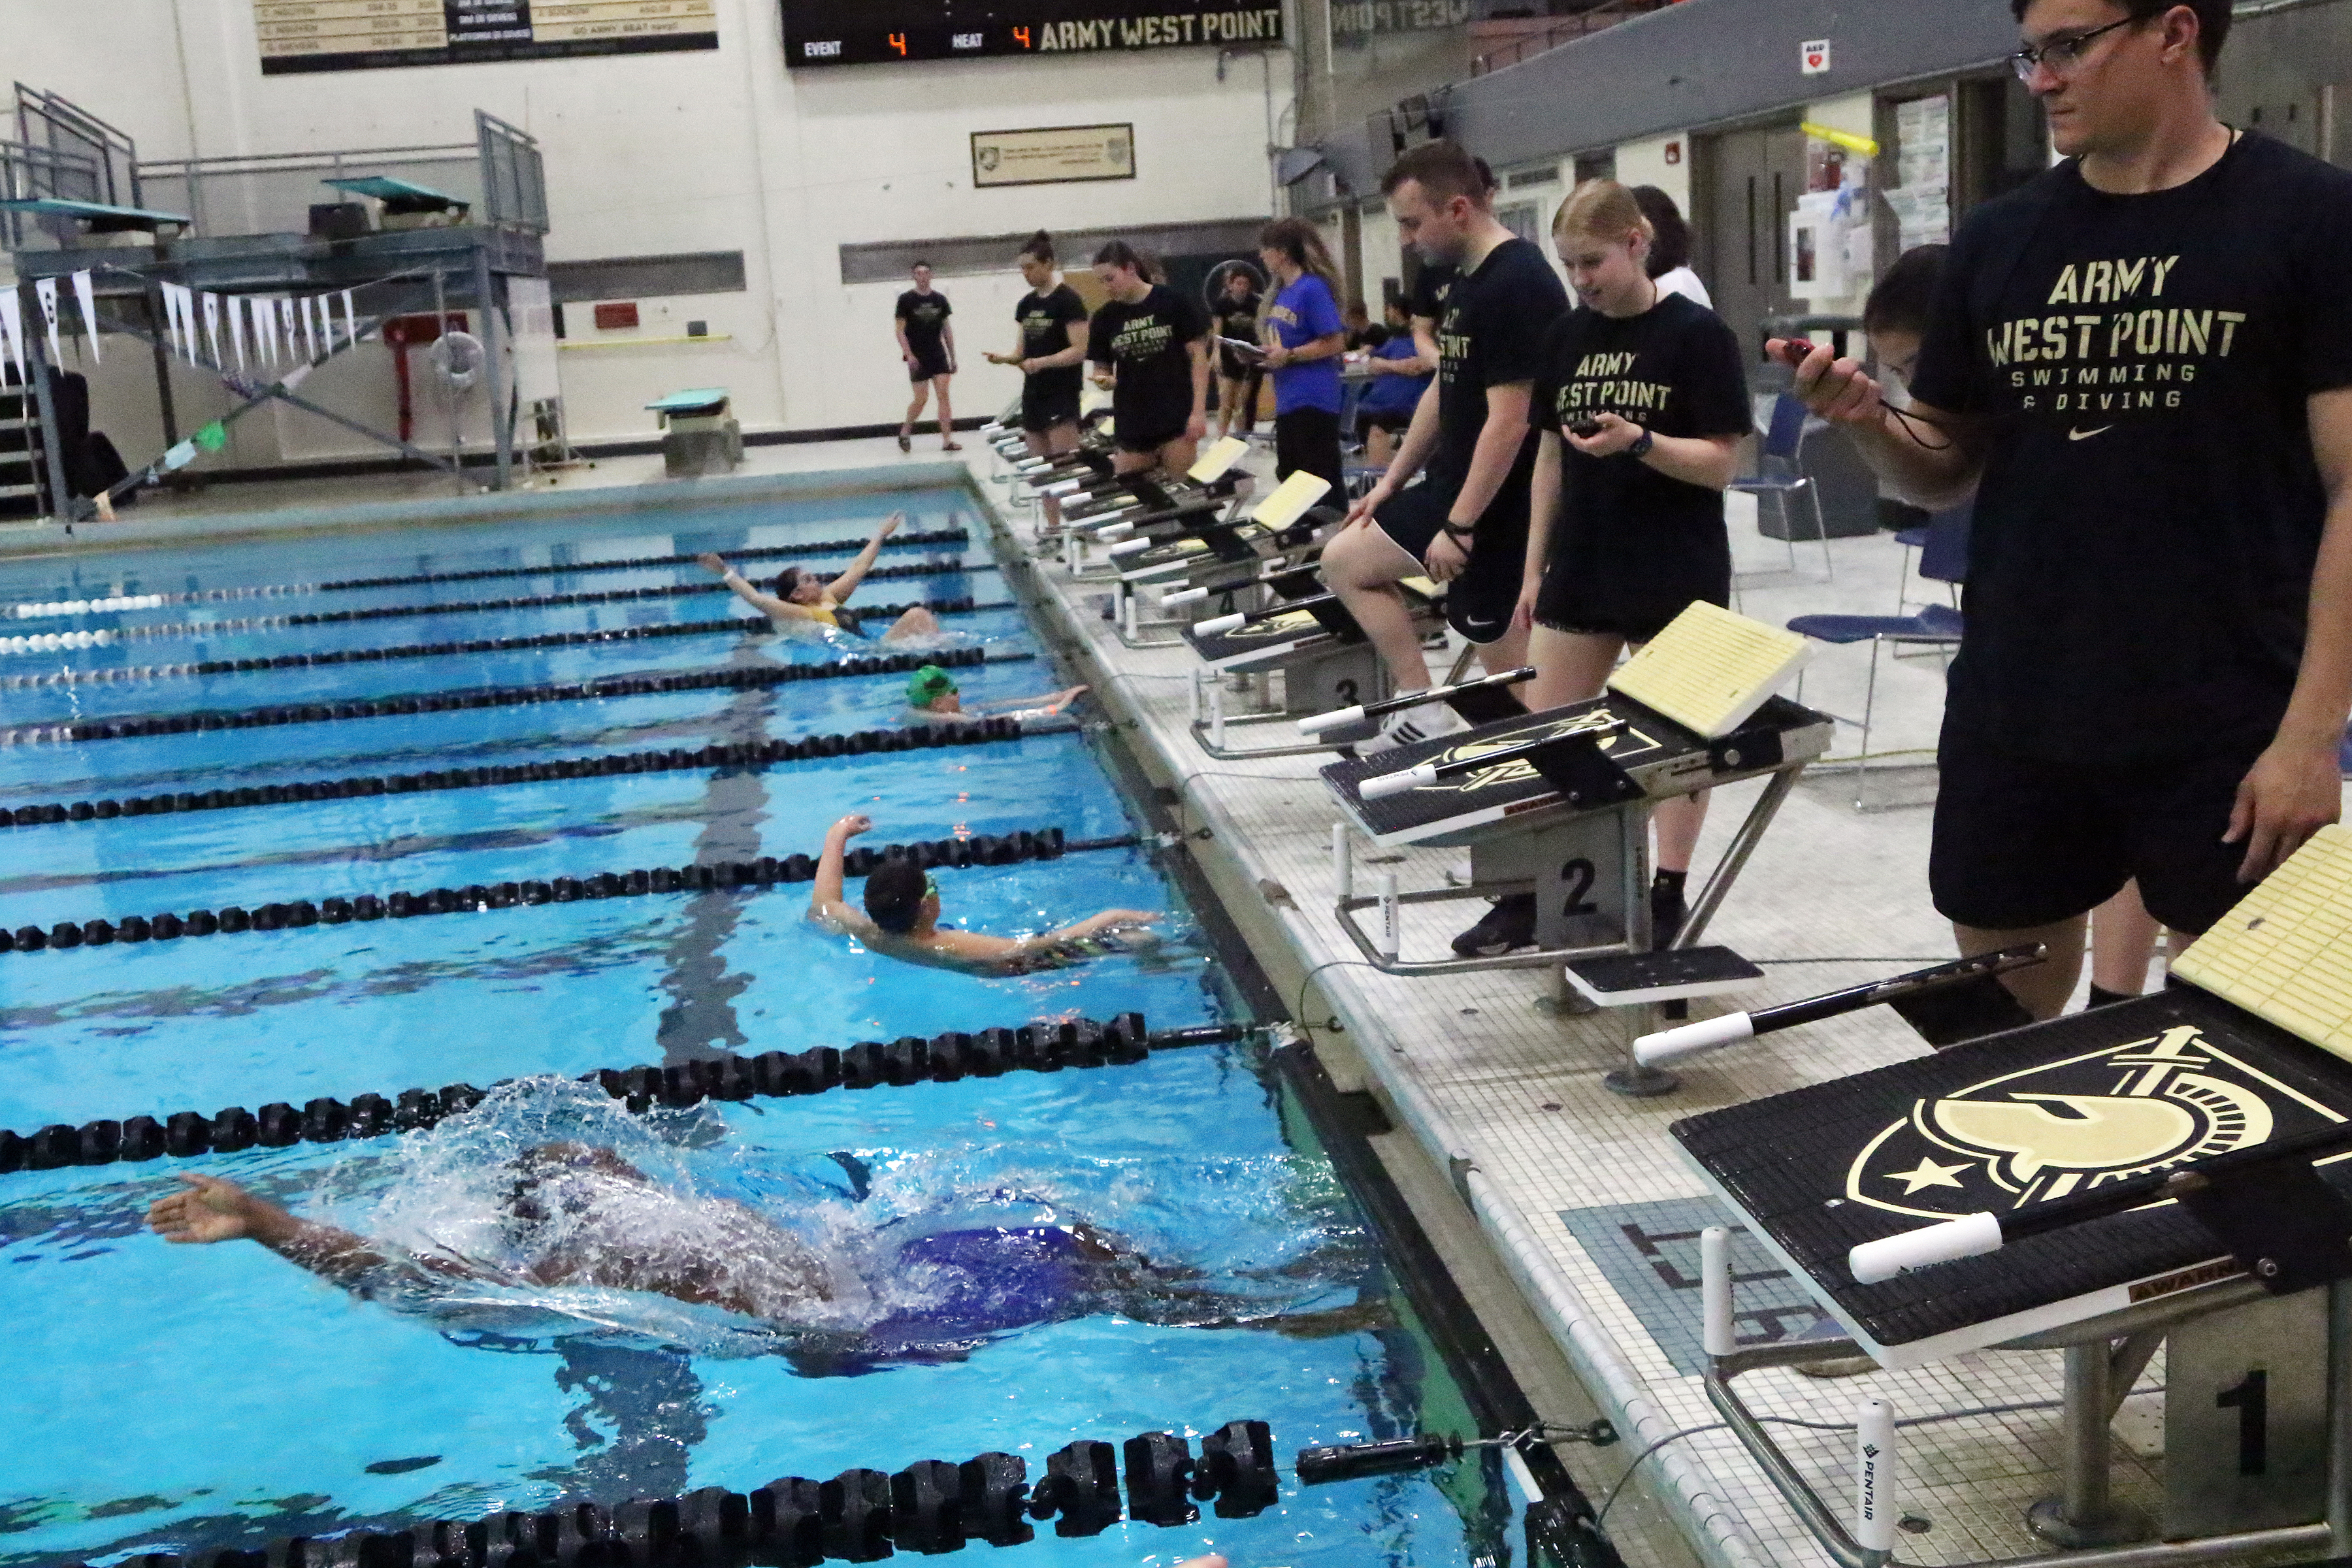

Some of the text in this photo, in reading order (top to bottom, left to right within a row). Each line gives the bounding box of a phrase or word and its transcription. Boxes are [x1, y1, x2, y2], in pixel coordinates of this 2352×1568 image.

[804, 33, 906, 57] EVENT 4
[953, 27, 1030, 48] HEAT 4
[1040, 9, 1279, 50] ARMY WEST POINT
[1806, 43, 1825, 52] AED
[2047, 255, 2180, 305] ARMY
[1123, 314, 1154, 332] ARMY
[1987, 308, 2246, 368] WEST POINT
[1575, 351, 1637, 377] ARMY
[2011, 363, 2196, 387] SWIMMING
[1600, 380, 1672, 411] POINT
[2056, 390, 2181, 410] DIVING
[1336, 678, 1360, 710] 3
[1561, 858, 1597, 916] 2
[2216, 1369, 2266, 1475] 1
[1864, 1460, 1874, 1520] PENTAIR
